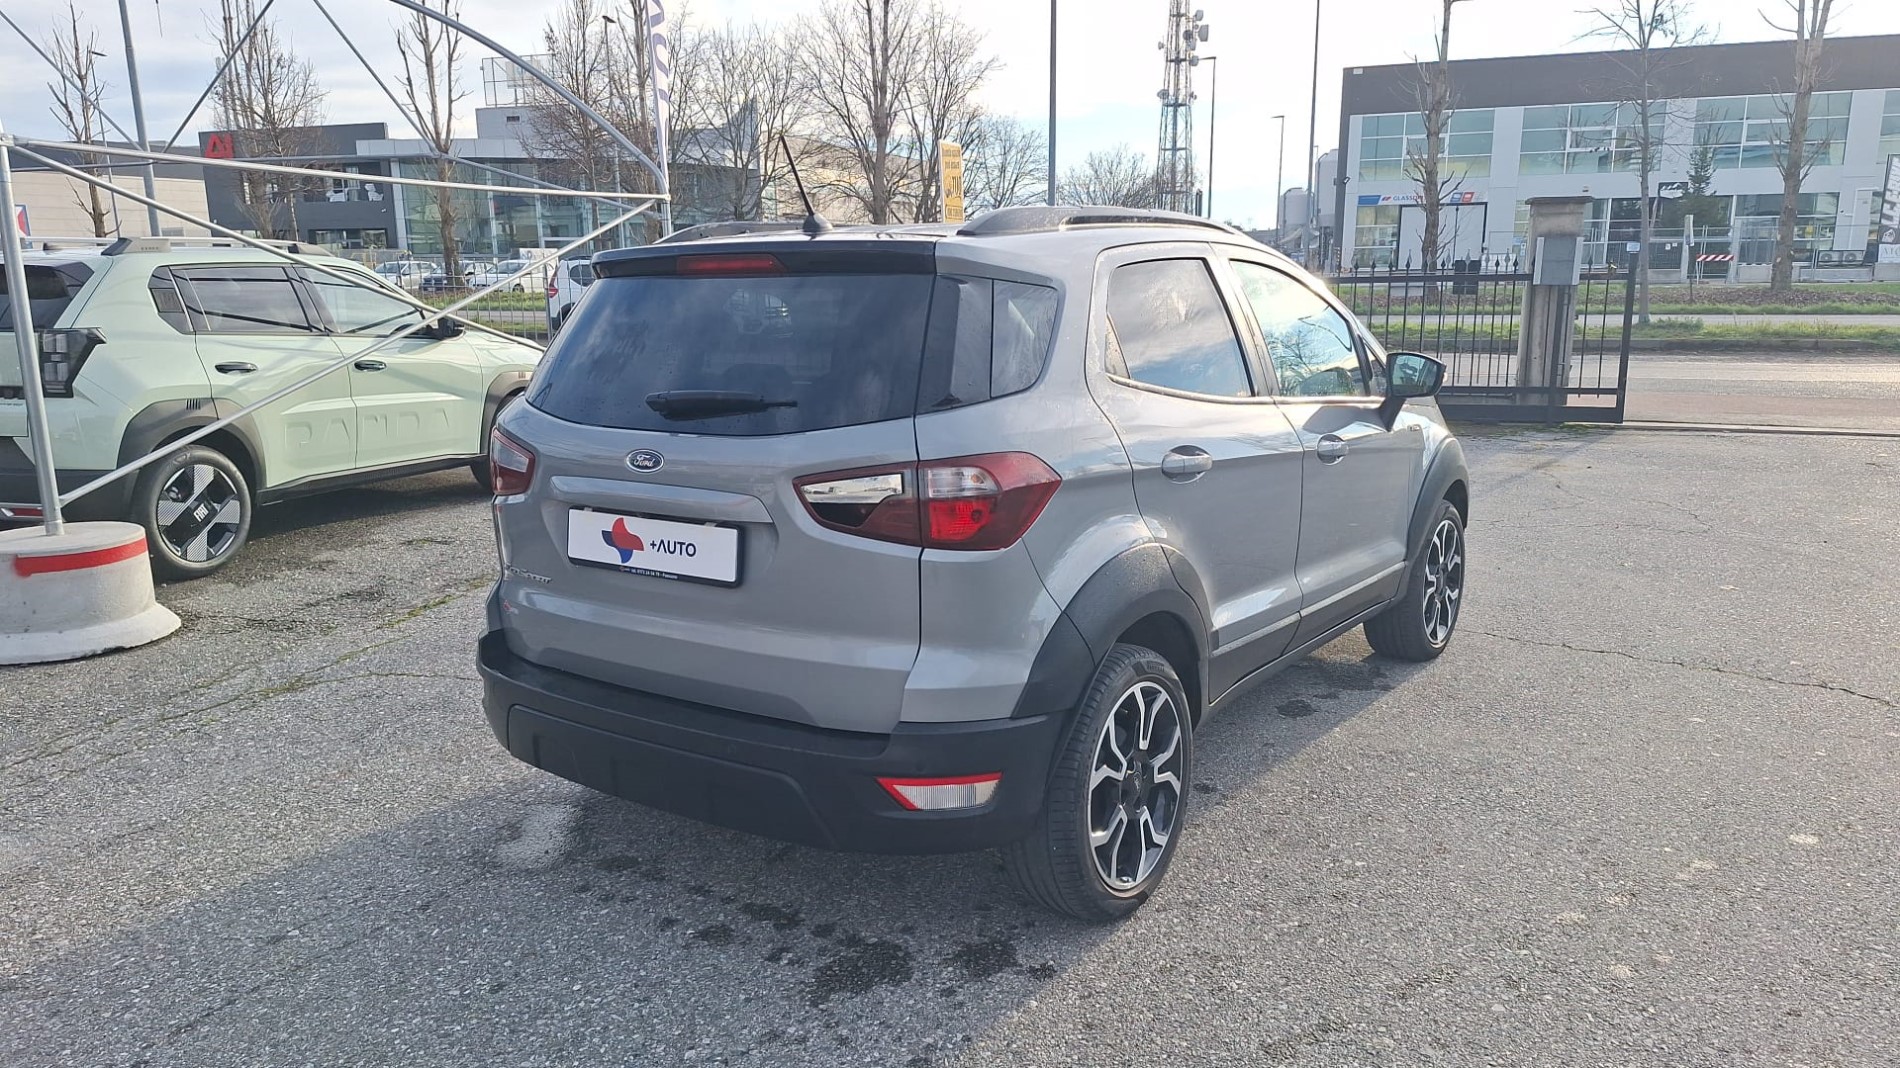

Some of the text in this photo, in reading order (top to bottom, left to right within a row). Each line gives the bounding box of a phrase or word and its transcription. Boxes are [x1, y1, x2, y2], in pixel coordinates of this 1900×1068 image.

[284, 407, 450, 450] PANDA
[193, 503, 209, 523] FIAT
[650, 539, 697, 558] +AUTO
